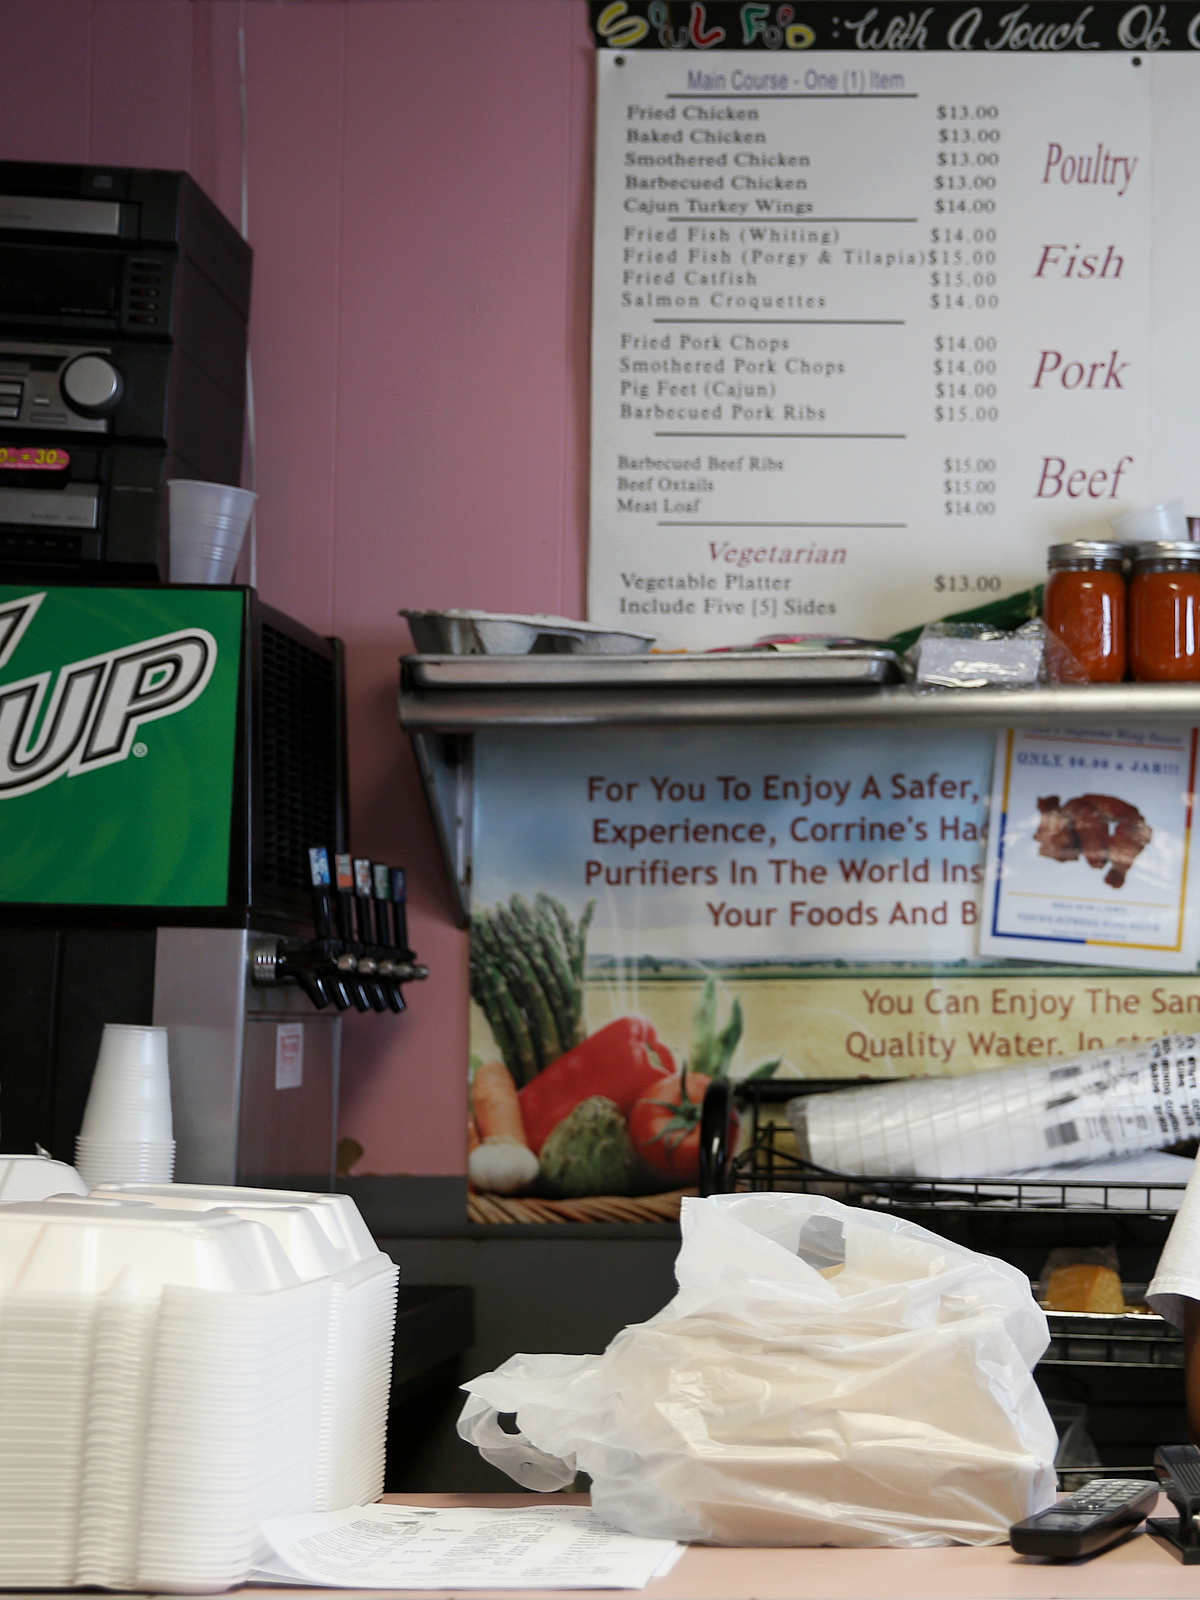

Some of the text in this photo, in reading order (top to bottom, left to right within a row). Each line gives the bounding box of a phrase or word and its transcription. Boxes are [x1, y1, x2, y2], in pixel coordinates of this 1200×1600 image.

[844, 7, 935, 50] With
[984, 3, 1100, 50] Touch
[687, 69, 727, 92] Main
[730, 68, 790, 92] Course
[803, 68, 839, 91] One
[842, 69, 866, 94] (1)
[867, 69, 906, 91] Item
[626, 104, 677, 121] Fried
[681, 105, 760, 122] Chicken
[626, 127, 684, 144] Baked
[689, 128, 767, 145] Chicken
[624, 151, 728, 168] Smothered
[733, 152, 811, 168] Chicken
[1042, 142, 1139, 197] Poultry
[624, 174, 725, 191] Barbecued
[730, 175, 808, 191] Chicken
[623, 197, 680, 216] Cajun
[686, 197, 749, 216] Turkey
[754, 198, 814, 217] Wings
[1032, 244, 1125, 279] Fish
[622, 269, 997, 288] Fried Catfish $15.00
[620, 332, 998, 355] Fried Pork Chops $14.00
[1031, 350, 1129, 390] Pork
[1034, 456, 1134, 499] Beef
[708, 541, 848, 569] Vegetarian
[619, 572, 1003, 594] Vegetable Platter $13.00
[619, 596, 696, 615] Include
[703, 596, 745, 615] Five
[783, 598, 837, 616] Sides
[587, 771, 980, 807] For You To Enjoy A Safer,
[592, 817, 777, 851] Experience,
[789, 815, 929, 844] Corrine's
[585, 859, 719, 887] Purifiers
[730, 859, 758, 885] In
[767, 858, 829, 885] The
[838, 857, 930, 884] World
[706, 901, 778, 928] Your
[789, 899, 879, 927] Foods
[888, 900, 948, 926] And
[861, 988, 915, 1016] You
[924, 988, 980, 1016] Can
[991, 988, 1075, 1022] Enjoy
[1084, 988, 1142, 1015] The
[845, 1030, 957, 1063] Quality
[966, 1031, 1065, 1060] Water.
